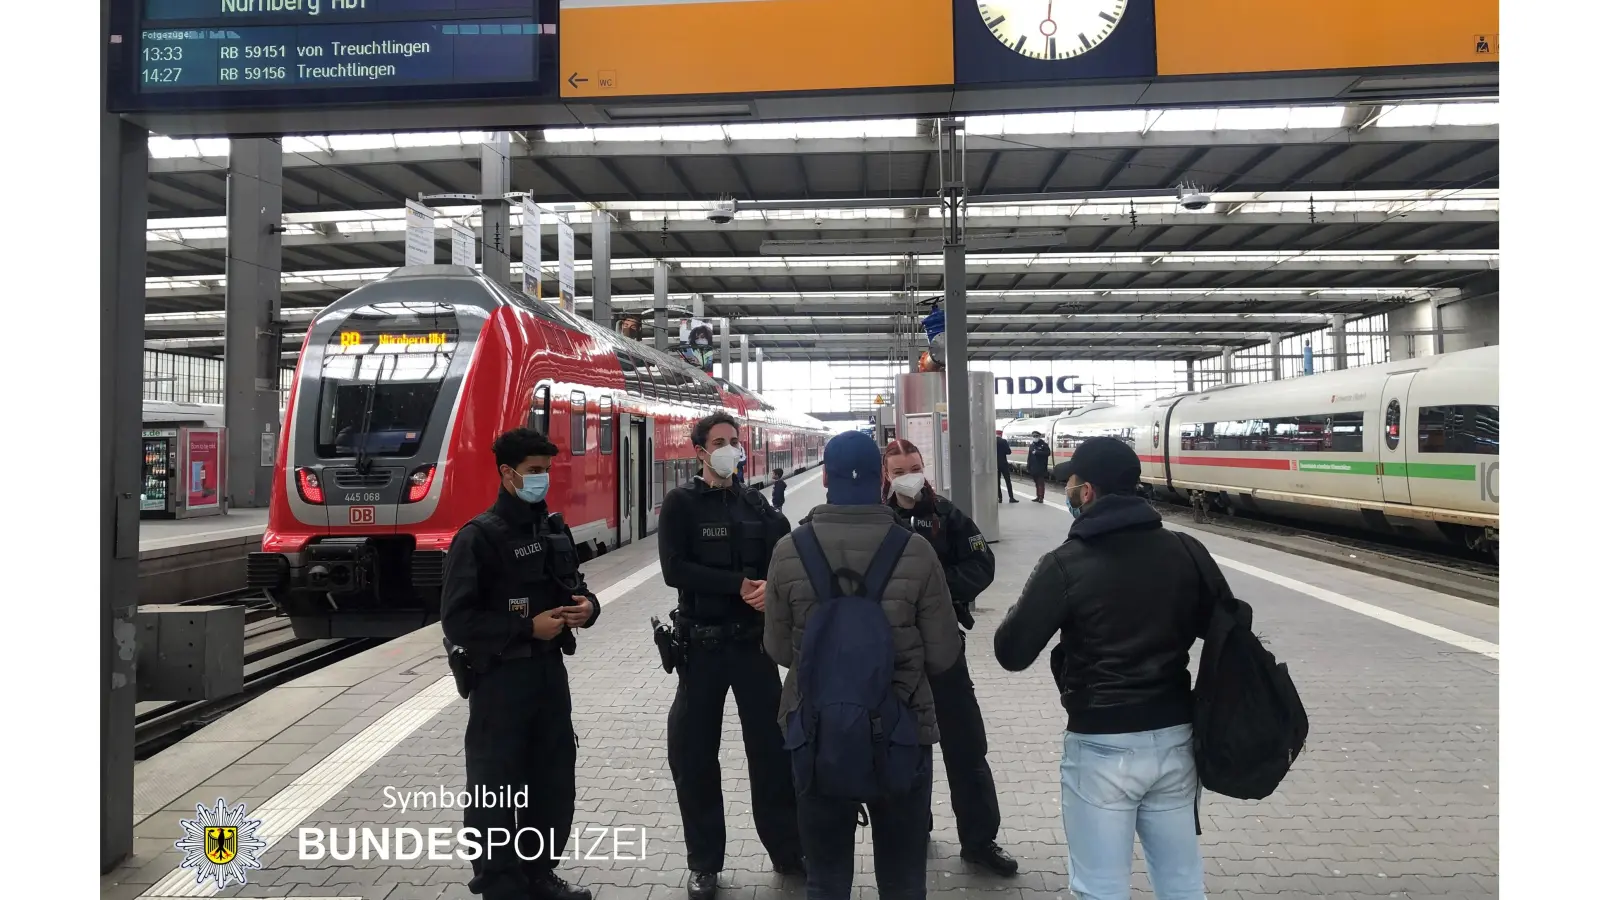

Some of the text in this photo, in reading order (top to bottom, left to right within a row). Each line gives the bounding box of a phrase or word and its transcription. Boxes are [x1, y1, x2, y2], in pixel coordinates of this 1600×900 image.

[142, 40, 430, 61] 13:33 RB 59151 von Treuchtlingen
[142, 62, 396, 83] 14:27 RB 59156 Treuchtlingen
[600, 79, 612, 87] WC
[345, 492, 380, 502] 445 068
[351, 508, 373, 522] DB
[702, 527, 728, 537] POLIZEI
[514, 541, 543, 558] POLIZEI
